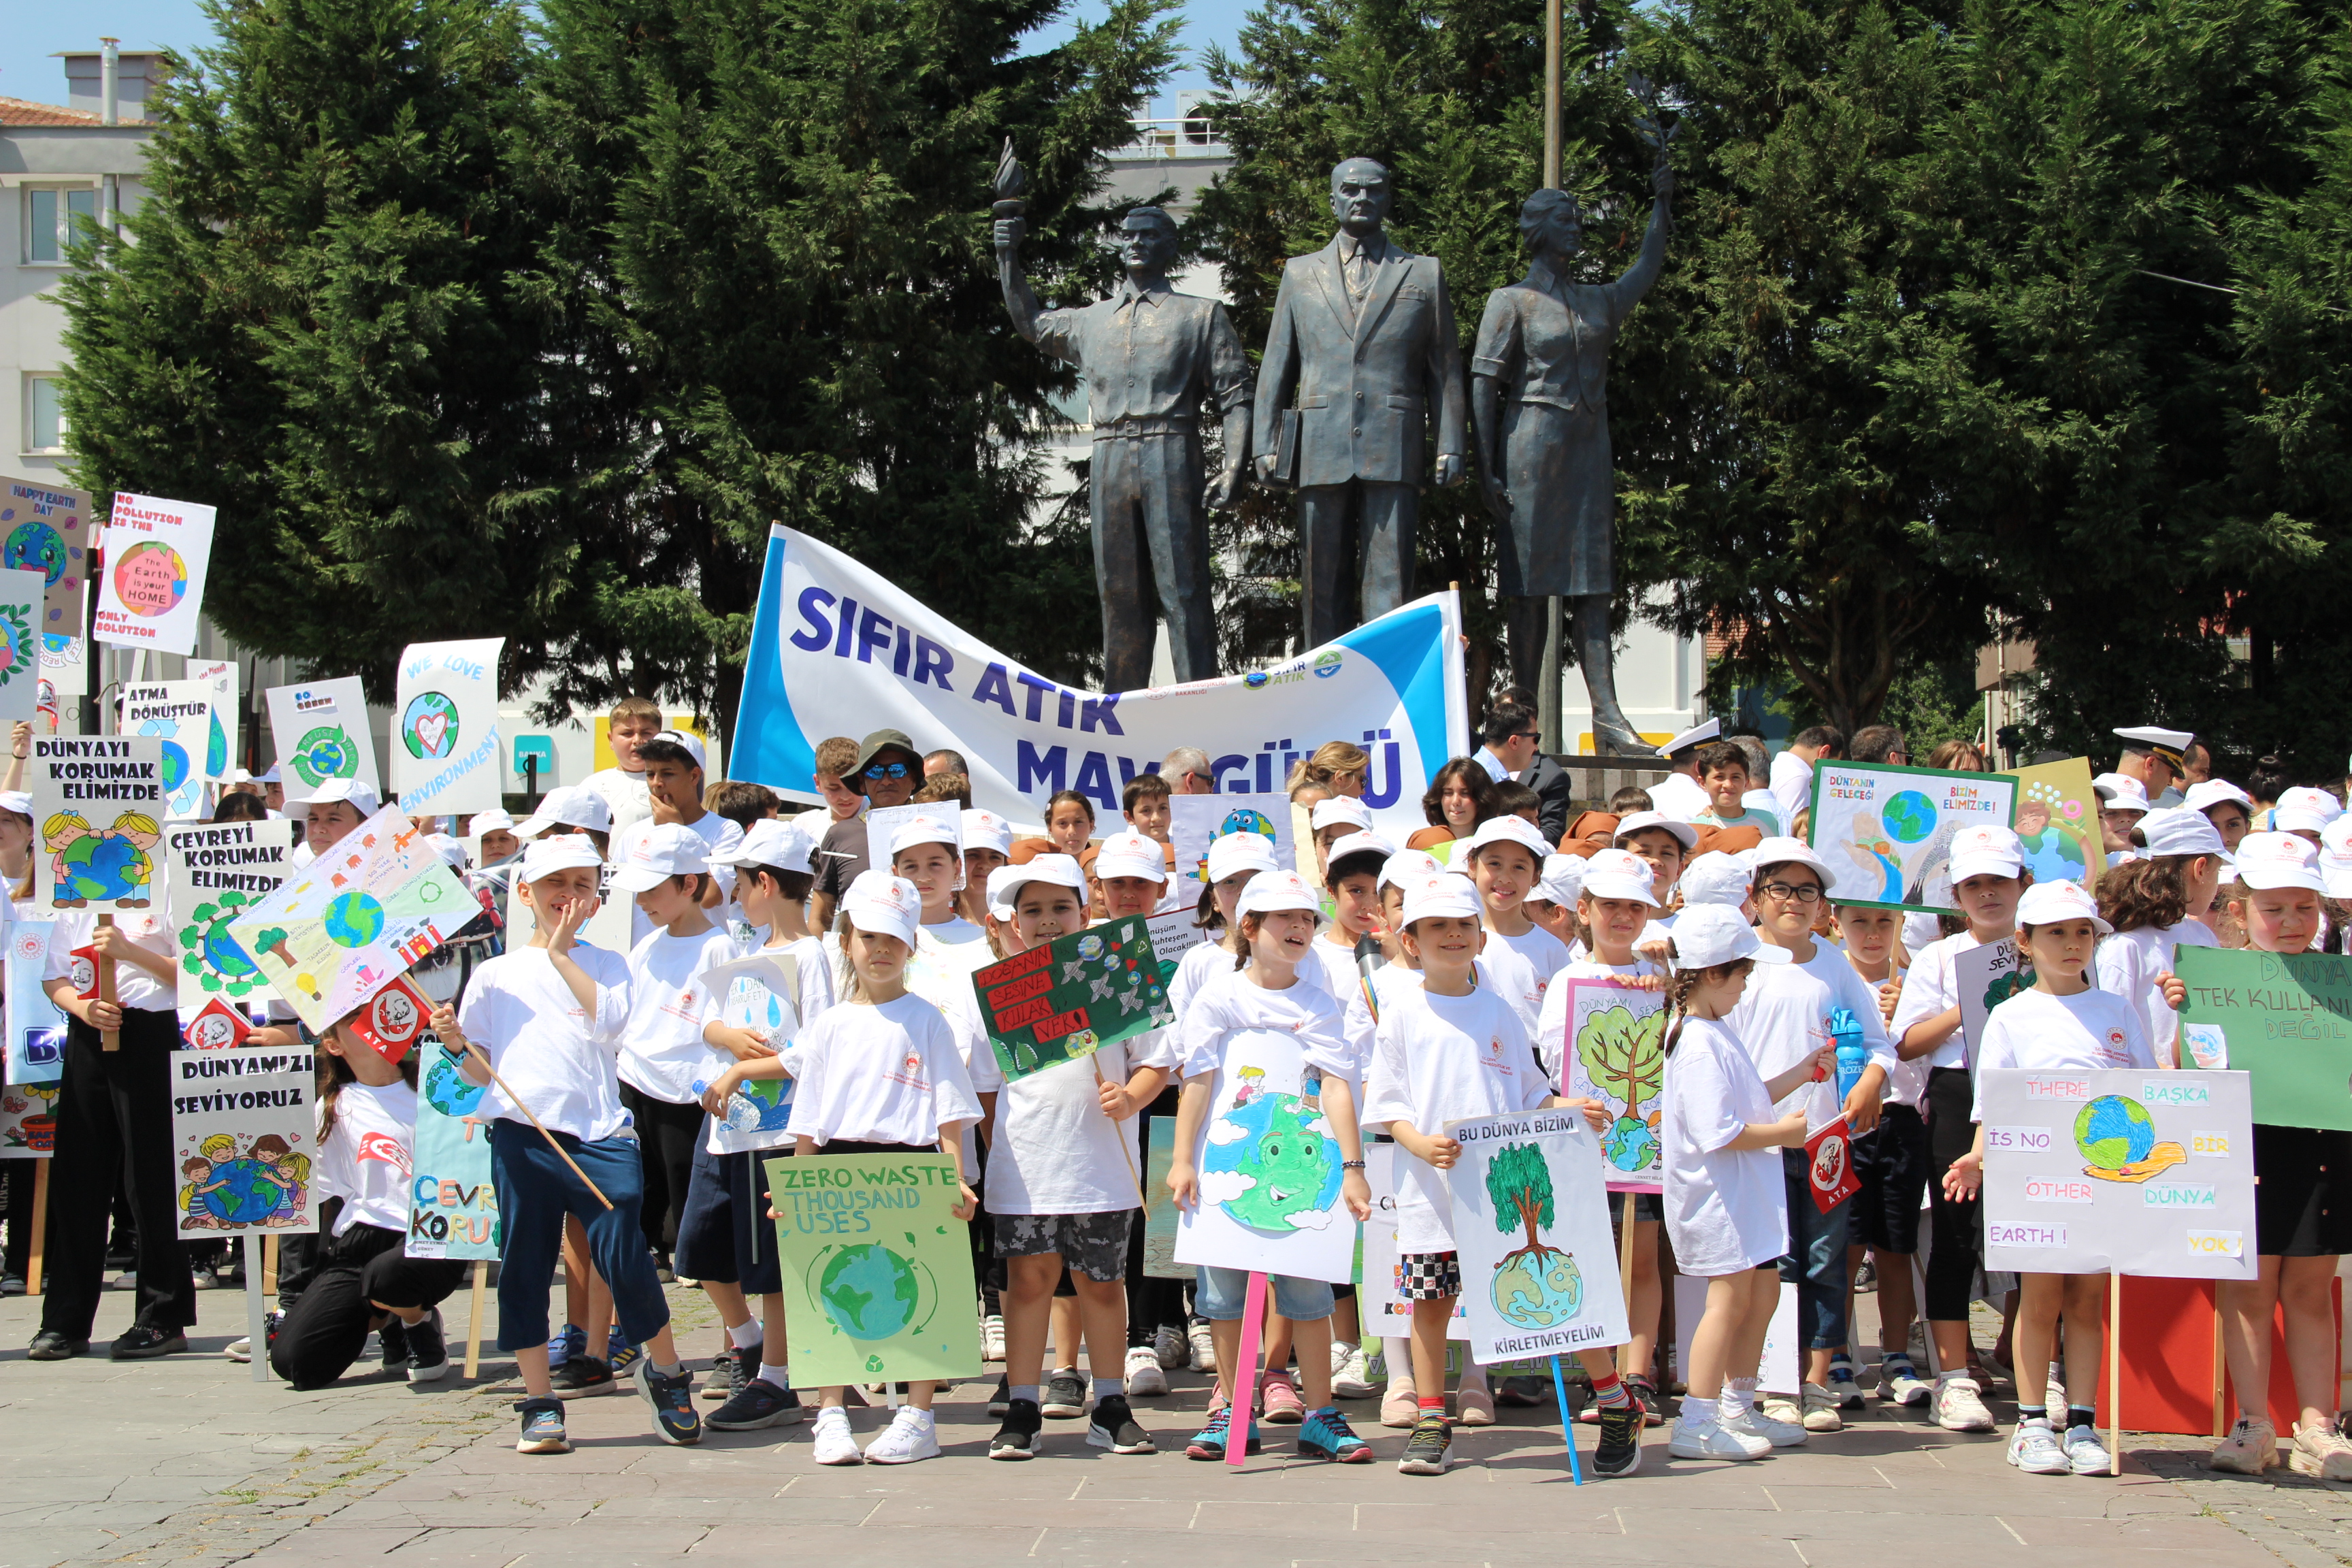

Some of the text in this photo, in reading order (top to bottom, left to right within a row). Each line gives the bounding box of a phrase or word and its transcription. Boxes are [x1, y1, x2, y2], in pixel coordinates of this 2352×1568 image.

[14, 485, 76, 508] HAPPY EARTH
[117, 494, 133, 504] NO
[34, 502, 53, 516] DAY
[116, 506, 182, 525] POLLUTION
[113, 517, 153, 532] IS THE
[145, 558, 161, 566] The
[135, 567, 170, 580] Earth
[128, 591, 167, 604] HOME
[144, 582, 165, 592] your
[97, 611, 129, 622] ONLY
[96, 623, 156, 638] SOLUTION
[406, 654, 485, 681] WE LOVE
[788, 585, 1126, 736] SIFIR ATIK
[1273, 670, 1305, 685] ATIK
[129, 687, 168, 702] ATMA
[295, 691, 311, 700] GO
[131, 700, 207, 721] DÖNÜŞTÜR
[35, 738, 130, 757] DÜNYAYI
[49, 762, 155, 779] KORUMAK
[400, 724, 500, 815] ENVIRONMENT
[63, 779, 159, 800] ELİMİZDE
[1829, 775, 1875, 789] DÜNYANIN
[1950, 785, 1978, 799] BİZİM
[1830, 787, 1874, 801] GELECEĞİ
[171, 821, 254, 853] ÇEVREYİ
[184, 846, 284, 868] KORUMAK
[979, 945, 1049, 987] DOĞANIN
[1580, 998, 1632, 1013] DÜNYAMI
[2193, 987, 2240, 1008] TEK
[1001, 1000, 1051, 1031] KULAK
[2265, 1013, 2346, 1040] DEĞİL
[363, 1030, 389, 1054] ATA
[182, 1054, 314, 1079] DÜNYAMIZI
[174, 1088, 303, 1115] SEVİYORUZ
[1573, 1076, 1616, 1109] ÇEVREMİ
[2026, 1080, 2209, 1104] THERE BAŞKA
[1459, 1116, 1574, 1142] BU DÜNYA BİZİM
[2021, 1133, 2051, 1148] NO
[2193, 1134, 2229, 1153] BİR
[779, 1165, 957, 1188] ZERO WASTE
[783, 1187, 921, 1212] THOUSAND
[1827, 1185, 1850, 1205] ATA
[2026, 1182, 2215, 1205] OTHER DÜNYA
[796, 1210, 871, 1235] USES
[1989, 1226, 2055, 1244] EARTH
[2189, 1237, 2229, 1253] YOK
[1494, 1324, 1605, 1355] KİRLETMEYELİM
